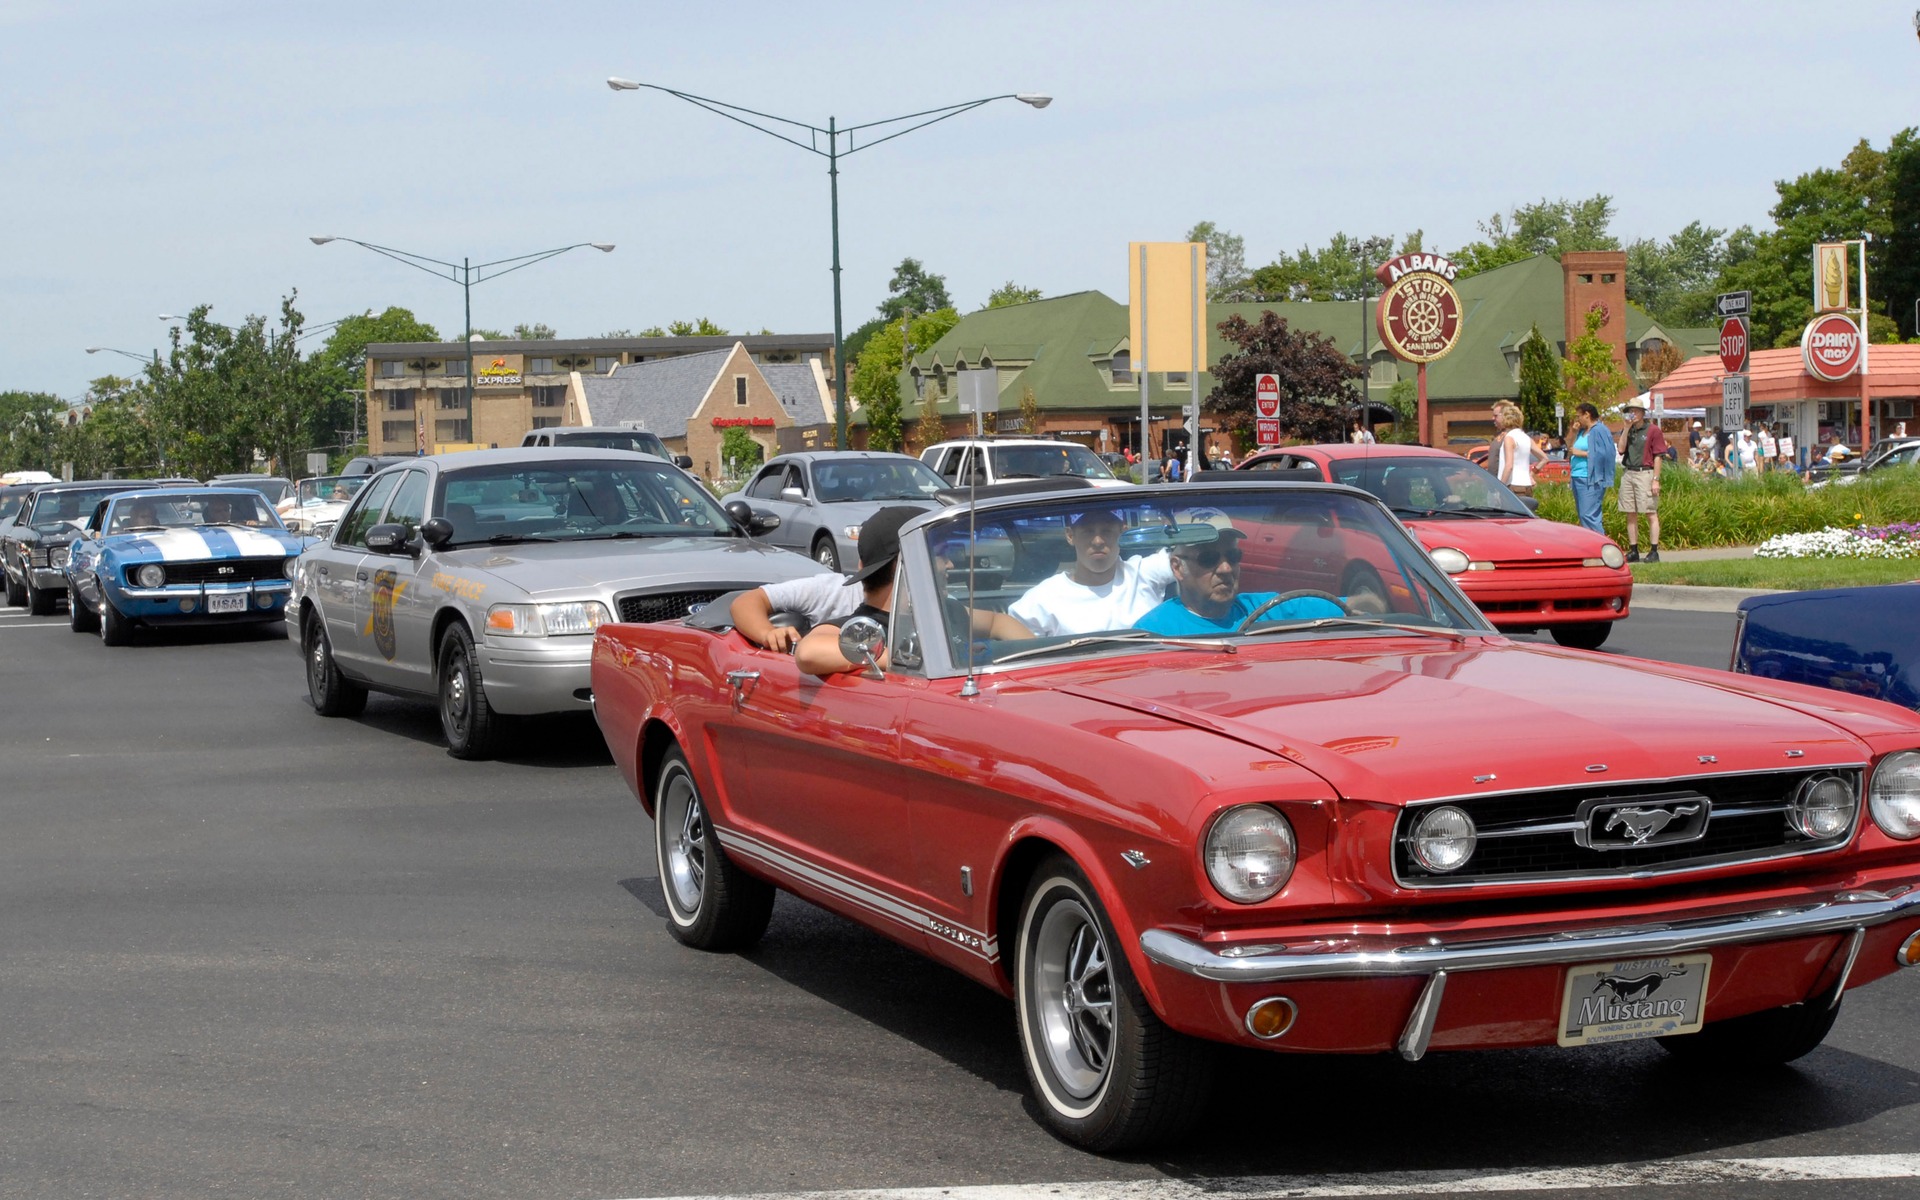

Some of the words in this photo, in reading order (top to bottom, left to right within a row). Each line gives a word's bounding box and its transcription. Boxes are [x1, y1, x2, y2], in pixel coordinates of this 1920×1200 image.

[1389, 255, 1458, 282] ALBANS
[1402, 280, 1441, 298] STOP
[1402, 294, 1418, 309] TURN
[1419, 292, 1428, 300] IN
[1725, 299, 1735, 309] ONE
[1735, 299, 1744, 307] WAY
[1407, 329, 1420, 341] BIG
[1420, 328, 1442, 343] WHEEL
[1812, 332, 1858, 348] DAIRY
[1406, 342, 1443, 351] SANDWICH
[1721, 335, 1744, 357] STOP
[1823, 348, 1847, 359] mat
[477, 376, 522, 384] EXPRESS
[1724, 382, 1742, 395] TURN
[1261, 401, 1275, 409] ENTER
[1725, 397, 1741, 411] LEFT
[712, 417, 749, 427] Flagstar
[751, 417, 774, 425] Bank
[1724, 413, 1742, 426] ONLY
[1259, 423, 1277, 432] WRONG
[1263, 433, 1275, 441] WAY
[218, 566, 234, 574] SS
[431, 572, 455, 592] STATE
[452, 577, 487, 600] POLICE
[1613, 958, 1670, 972] MUSTANG
[1577, 995, 1687, 1026] Mustang
[1597, 1024, 1624, 1033] OWNERS
[1625, 1022, 1642, 1031] CLUB
[1645, 1021, 1654, 1029] OF
[1586, 1032, 1633, 1044] SOUTHEASTERN
[1635, 1029, 1664, 1039] MICHIGAN
